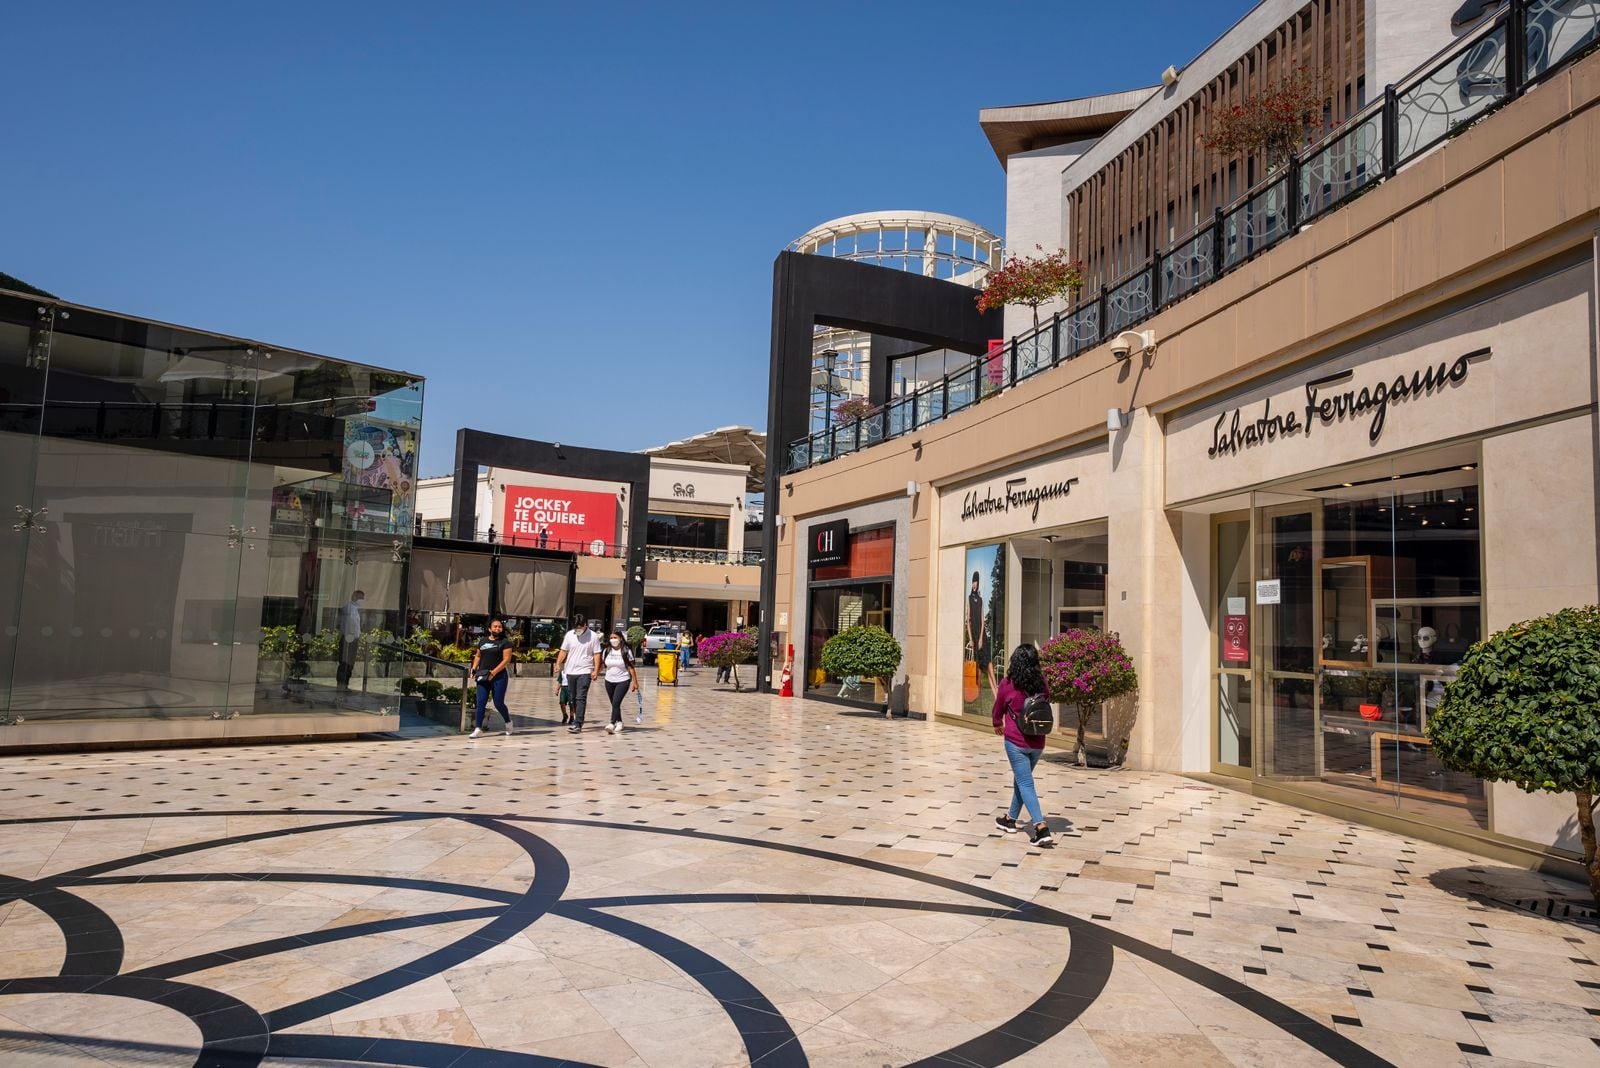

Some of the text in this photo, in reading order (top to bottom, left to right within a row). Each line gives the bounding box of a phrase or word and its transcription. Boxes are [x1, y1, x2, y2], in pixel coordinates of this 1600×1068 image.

[1208, 346, 1492, 455] Salvatore Ferragamo
[514, 496, 572, 512] JOCKEY
[961, 477, 1078, 522] Salvatore Ferragamo
[513, 508, 586, 525] TE QUIERE
[817, 530, 833, 553] CH
